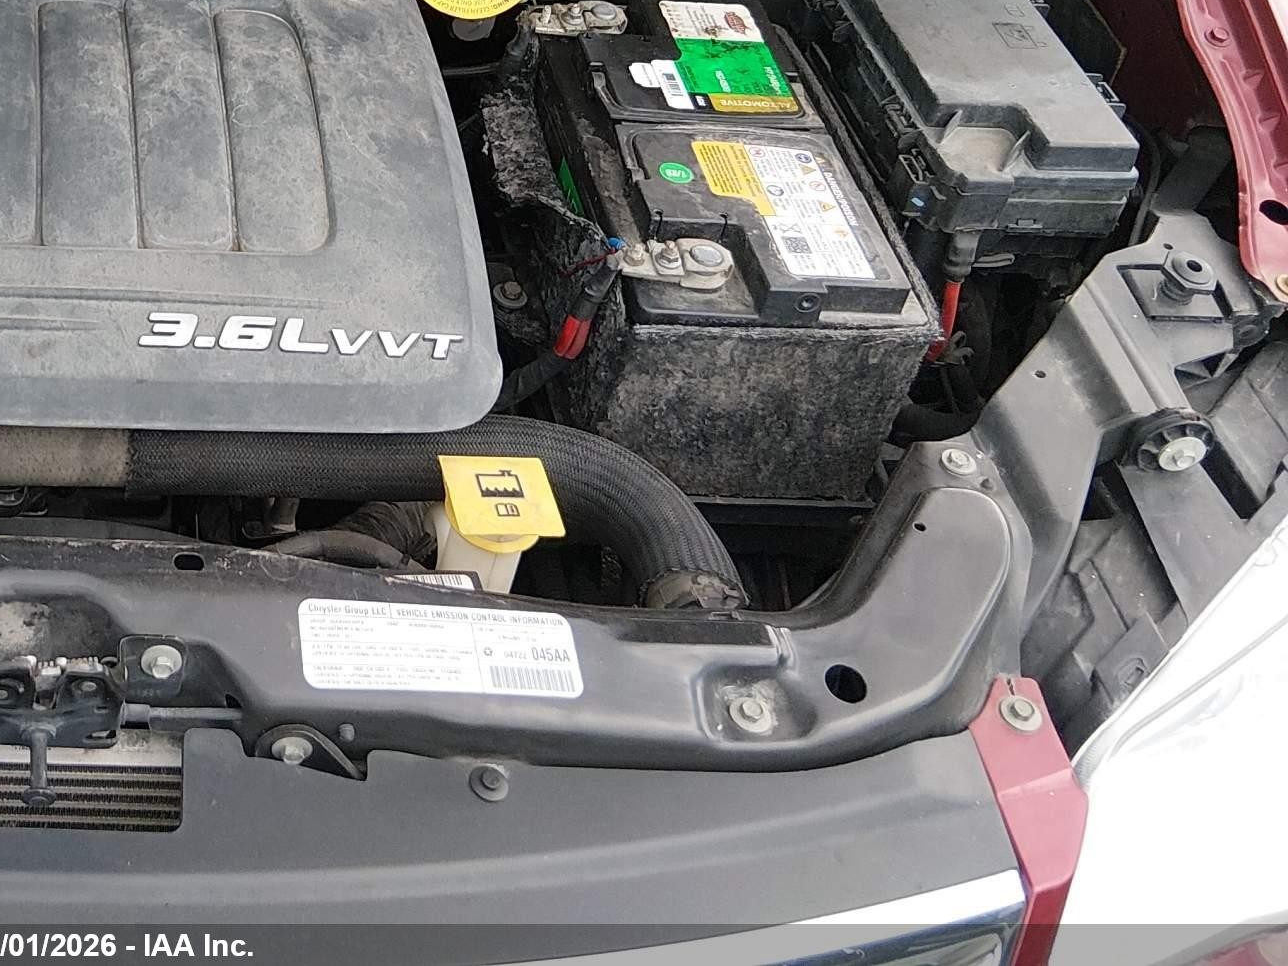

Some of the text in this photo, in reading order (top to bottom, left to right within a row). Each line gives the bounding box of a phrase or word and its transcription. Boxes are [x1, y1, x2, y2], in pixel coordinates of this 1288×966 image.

[138, 312, 464, 361] 3.6L VVT
[308, 602, 564, 627] Chrysler Group LLC VEHICLE EMISSION CONTROL INFORMATION
